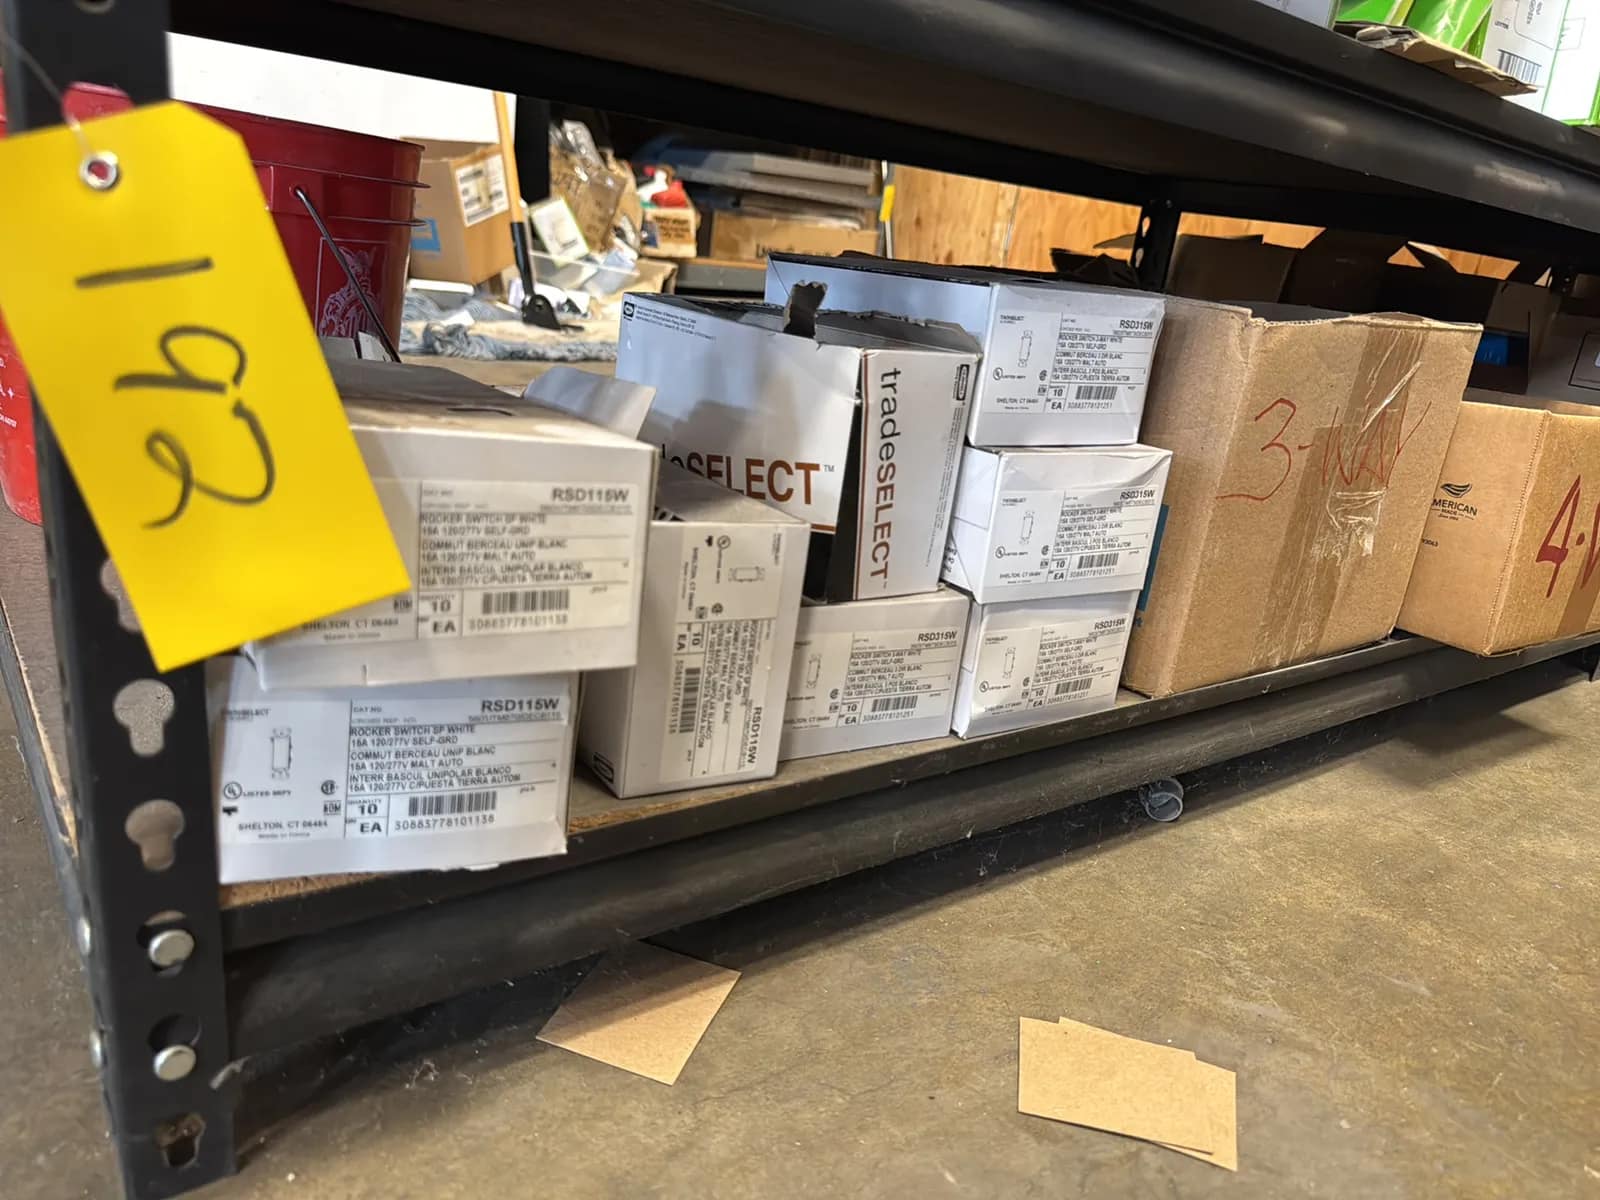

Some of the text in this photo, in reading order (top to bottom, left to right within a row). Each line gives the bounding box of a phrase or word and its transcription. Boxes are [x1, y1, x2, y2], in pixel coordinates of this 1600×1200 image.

[1119, 320, 1153, 329] RSD315W
[662, 444, 820, 504] SELECT
[870, 367, 901, 580] tradeSELECT
[552, 488, 629, 501] RSD115W
[1120, 490, 1155, 500] RSD315W
[1431, 499, 1477, 516] MERICAN
[431, 601, 451, 612] 10
[432, 620, 456, 633] EA
[1094, 618, 1126, 629] RSD315W
[676, 633, 686, 650] EA
[691, 631, 701, 645] 10
[918, 631, 957, 642] RSD315W
[481, 698, 560, 712] RSD115W
[845, 716, 856, 724] EA
[351, 724, 476, 736] ROCKER SWITCH SP WHITE
[746, 706, 762, 764] RSD115W
[352, 735, 458, 748] 15A 120/277V SELF-GRD
[351, 746, 495, 760] COMMUT BERCEAU UNIP BLANC
[351, 758, 463, 771] 15A 120/277V MALT AUTO
[350, 766, 511, 783] INTERR BASCUL UNIPOLAR BLANCO
[350, 774, 520, 792] 15A 120/277V C/PUESTA TIERRA AUTOM
[358, 804, 377, 815] 10
[360, 822, 382, 833] EA
